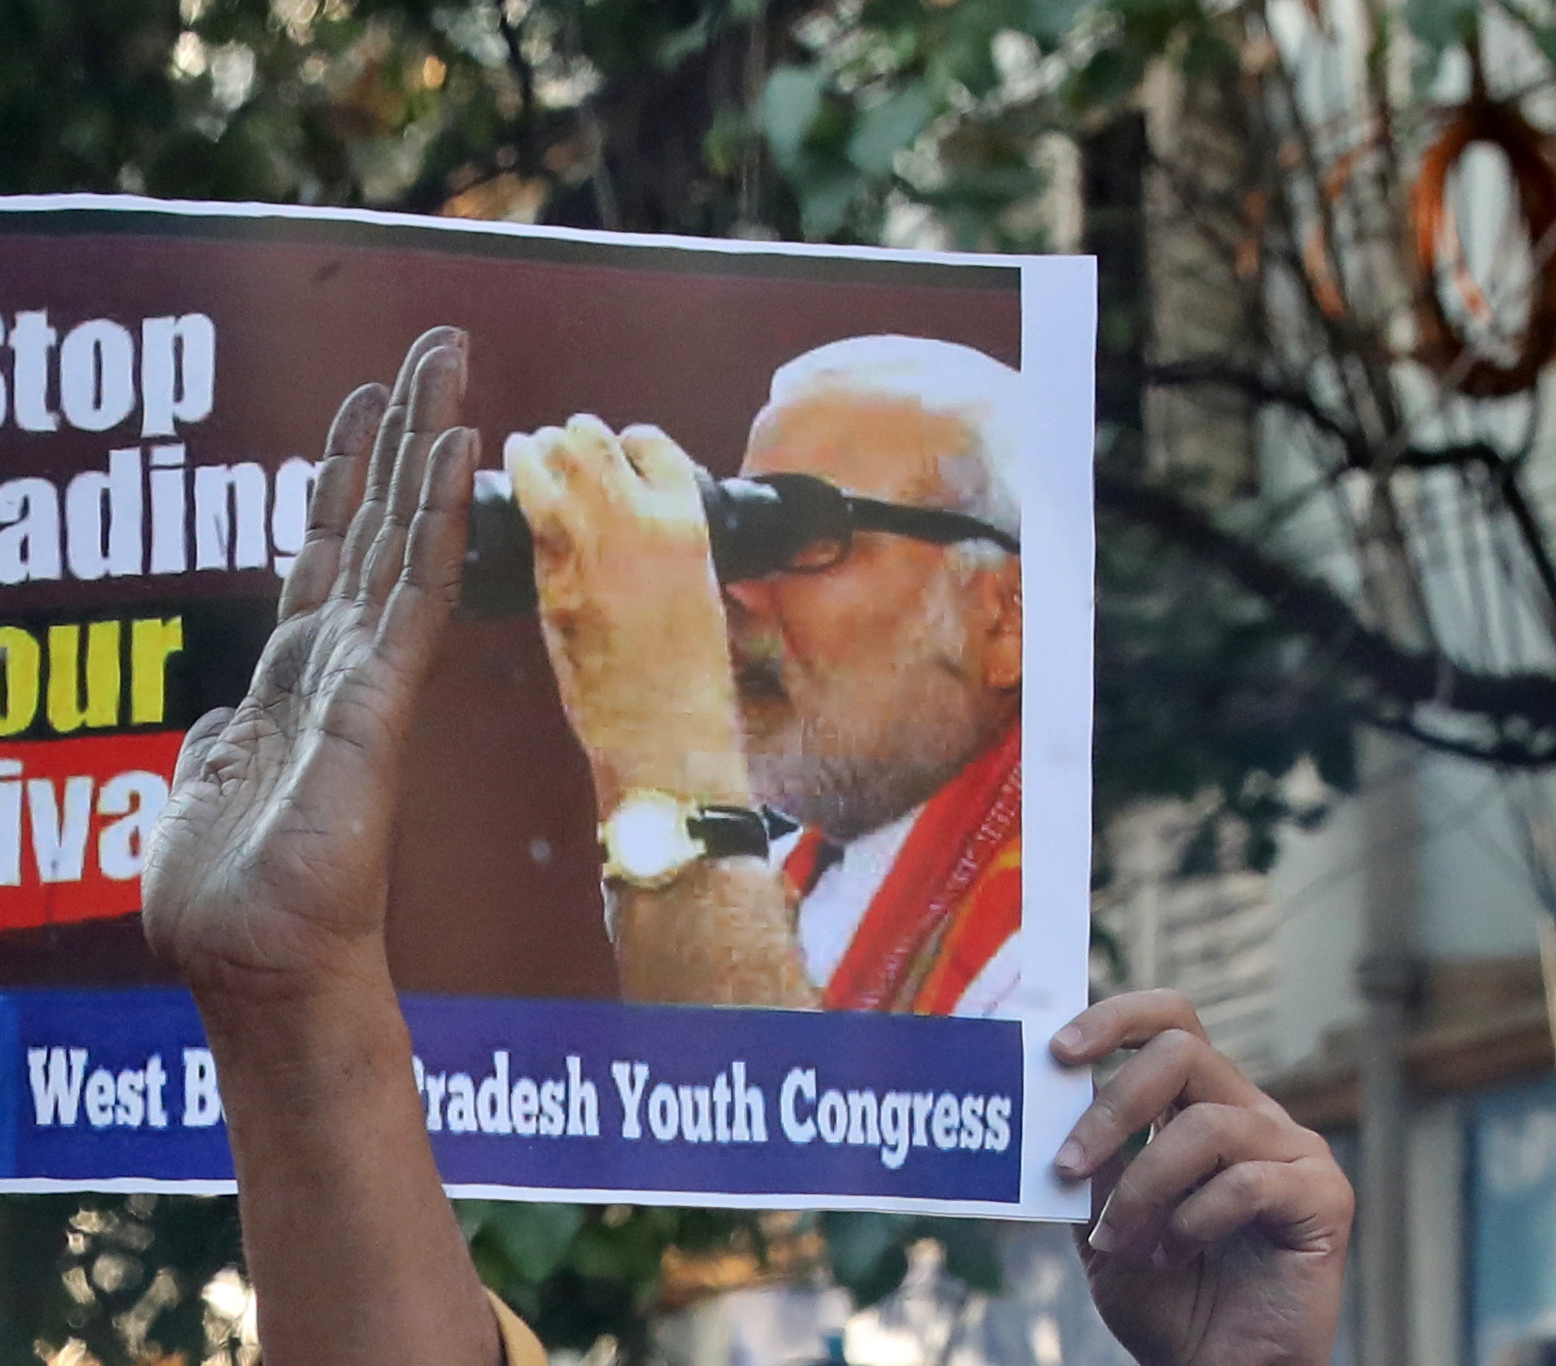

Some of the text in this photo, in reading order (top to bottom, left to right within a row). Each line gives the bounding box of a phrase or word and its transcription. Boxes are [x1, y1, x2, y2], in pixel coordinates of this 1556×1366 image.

[28, 1047, 167, 1127] West
[611, 1060, 768, 1143] Youth
[780, 1067, 1011, 1169] Congress
